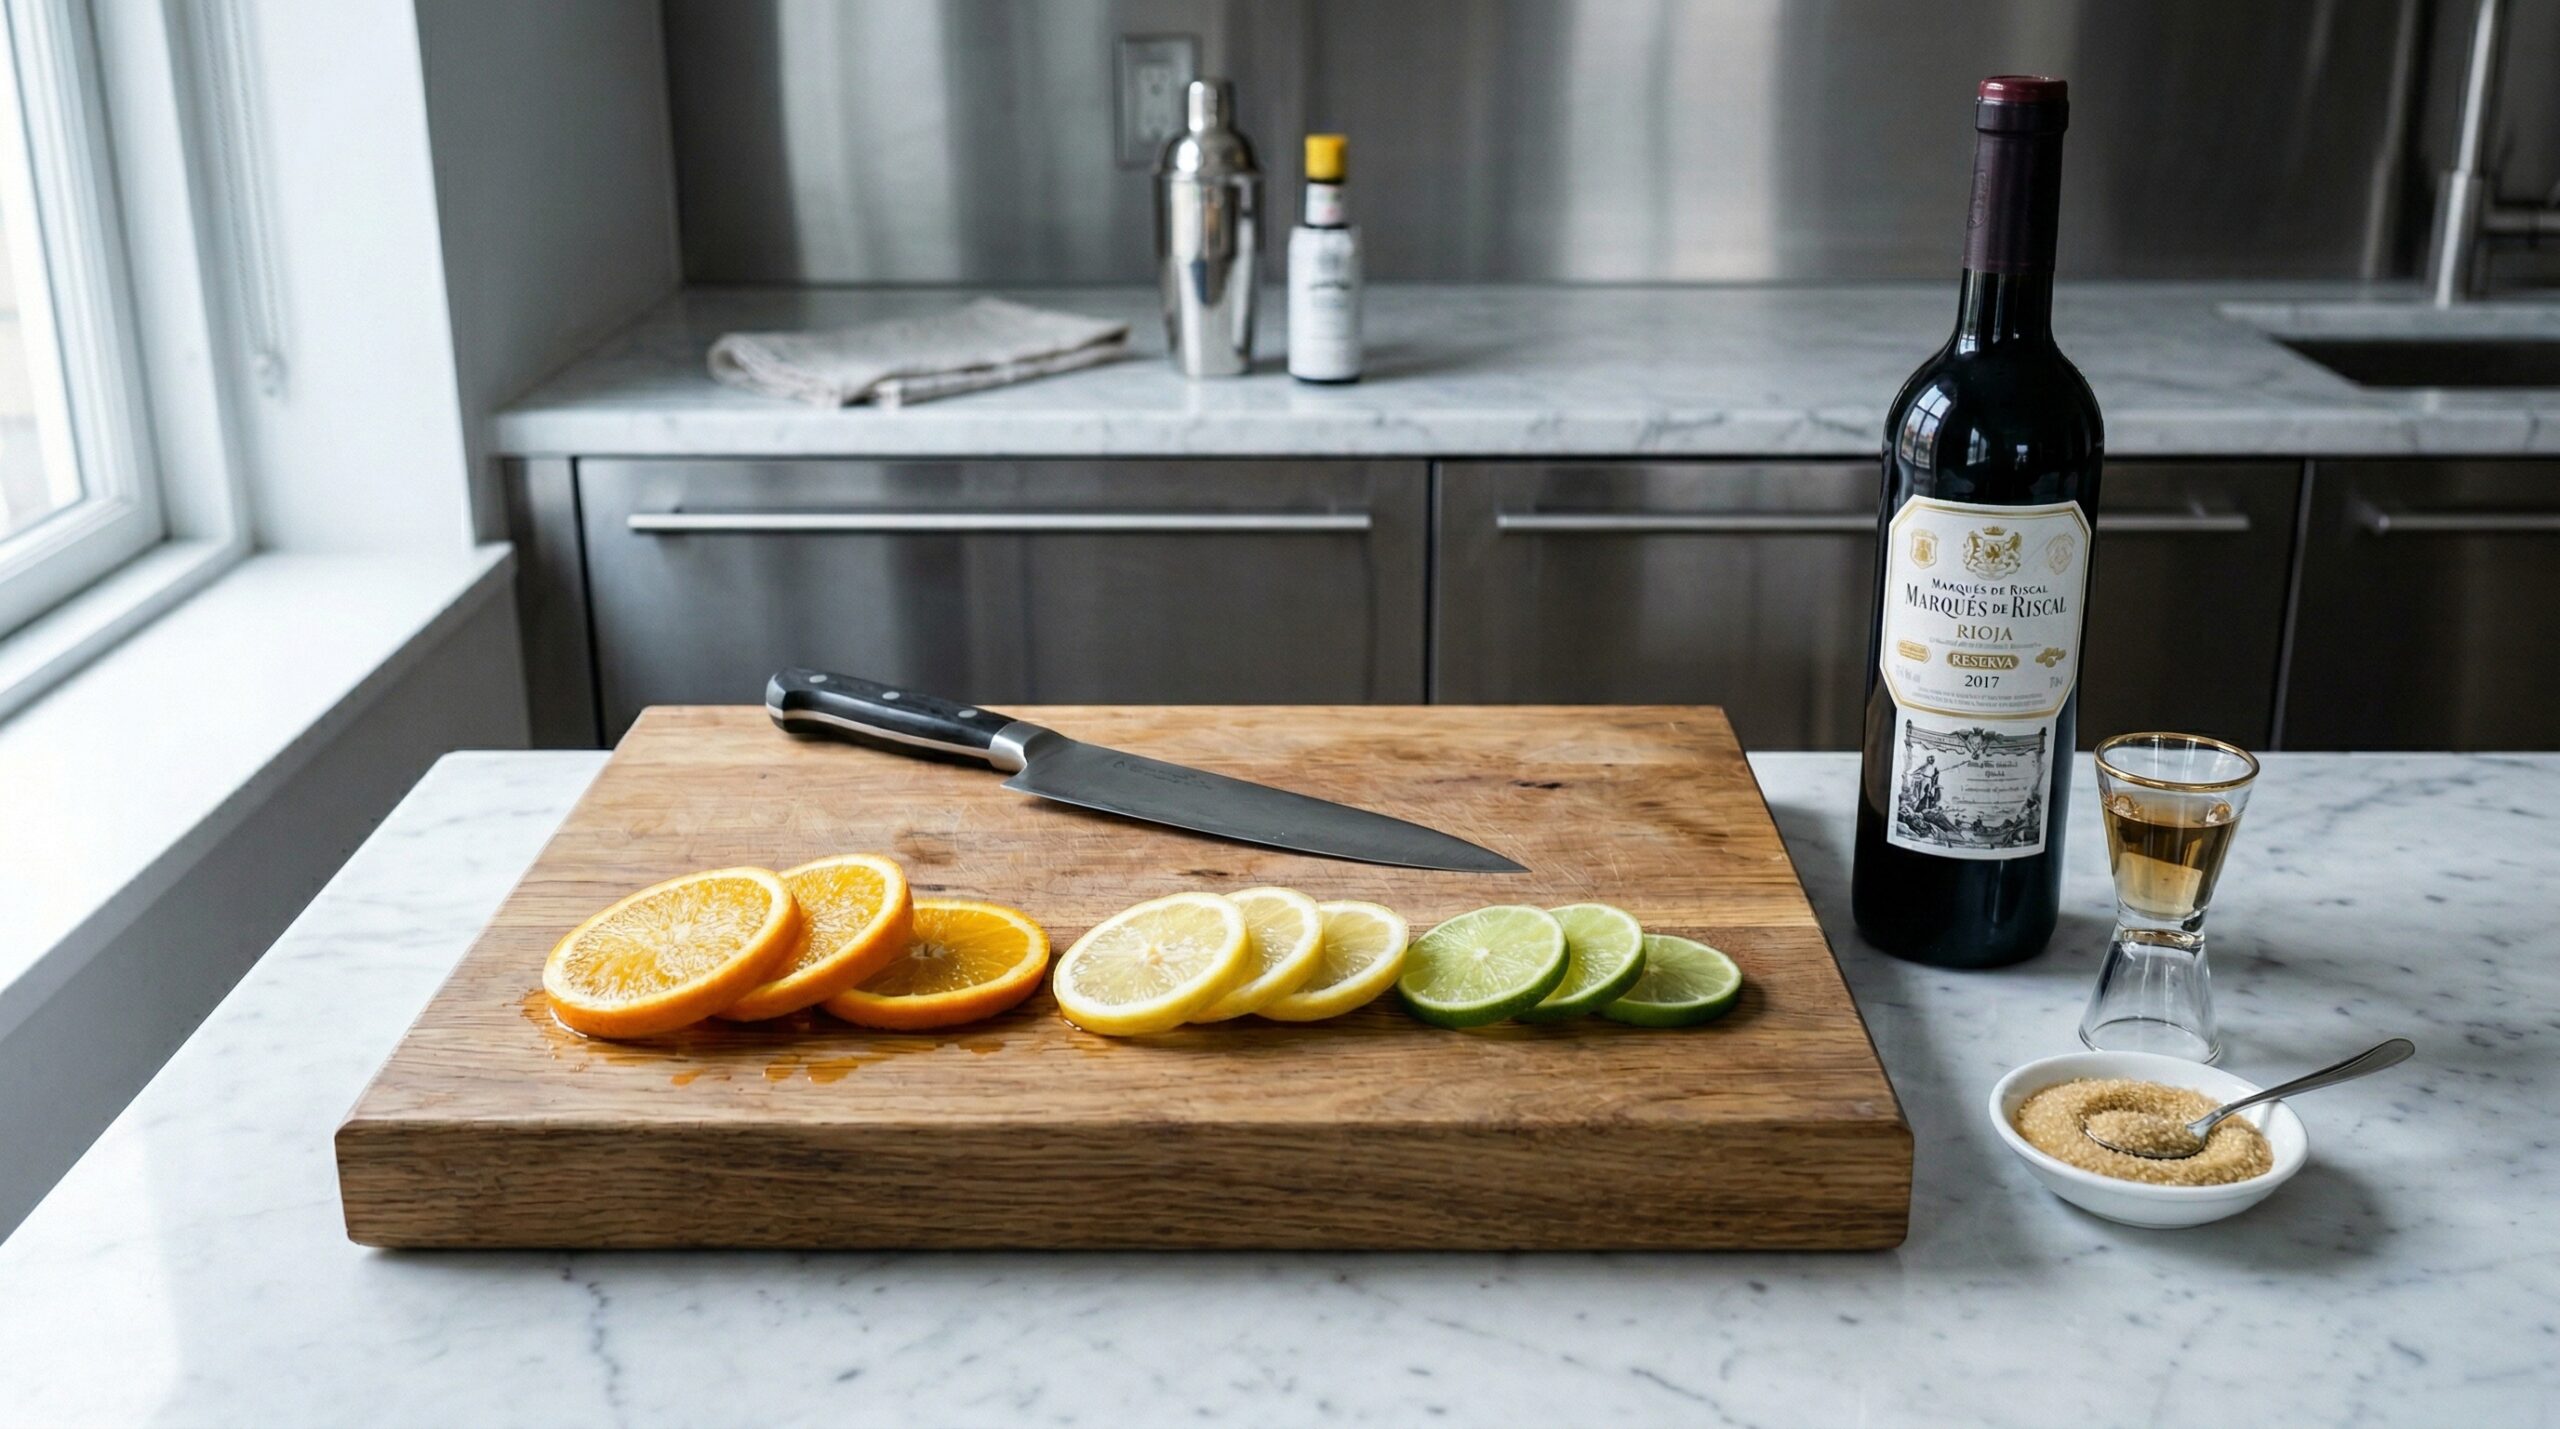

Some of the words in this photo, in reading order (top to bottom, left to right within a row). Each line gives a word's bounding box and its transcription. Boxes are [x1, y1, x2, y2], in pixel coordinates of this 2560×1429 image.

[1906, 583, 1987, 619] MARQUÉS
[1992, 604, 2008, 614] DE
[2012, 597, 2067, 618] RISCAL
[1957, 624, 2013, 643] RIOJA
[1952, 654, 2014, 668] RESERVA
[1964, 674, 2000, 688] 2017
